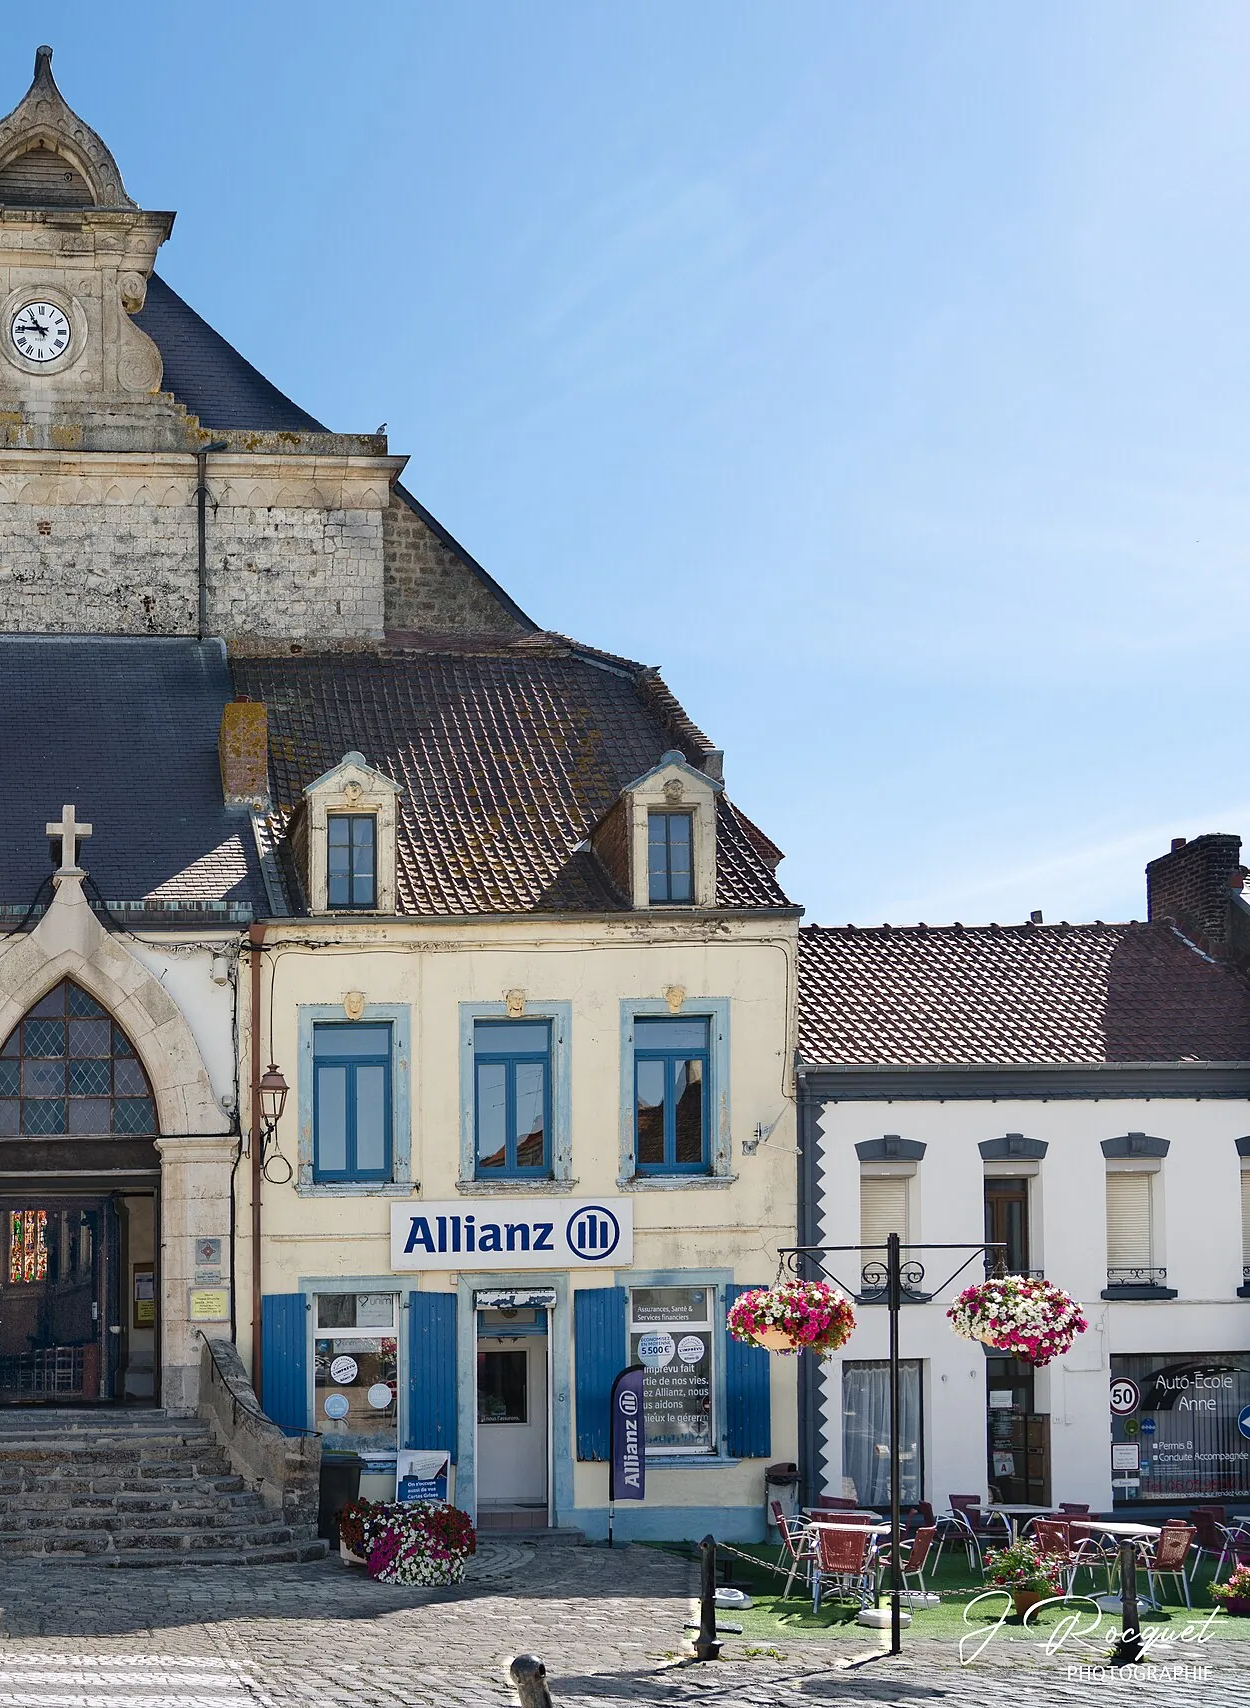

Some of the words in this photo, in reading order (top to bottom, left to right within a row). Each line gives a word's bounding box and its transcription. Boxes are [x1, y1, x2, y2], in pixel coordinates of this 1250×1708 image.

[404, 1215, 554, 1254] Allianz
[680, 1364, 694, 1372] fait
[659, 1377, 670, 1385] de
[689, 1376, 709, 1384] vies.
[558, 1392, 565, 1402] 5
[655, 1388, 686, 1397] Allianz,
[1112, 1388, 1133, 1404] 50
[656, 1401, 683, 1409] aidons
[1178, 1396, 1216, 1411] Anne
[668, 1412, 675, 1422] le
[1158, 1442, 1184, 1450] Permis
[1186, 1441, 1193, 1449] B
[624, 1420, 640, 1488] Allianz
[1158, 1453, 1192, 1462] Conduite
[1194, 1452, 1249, 1462] Accompagnée
